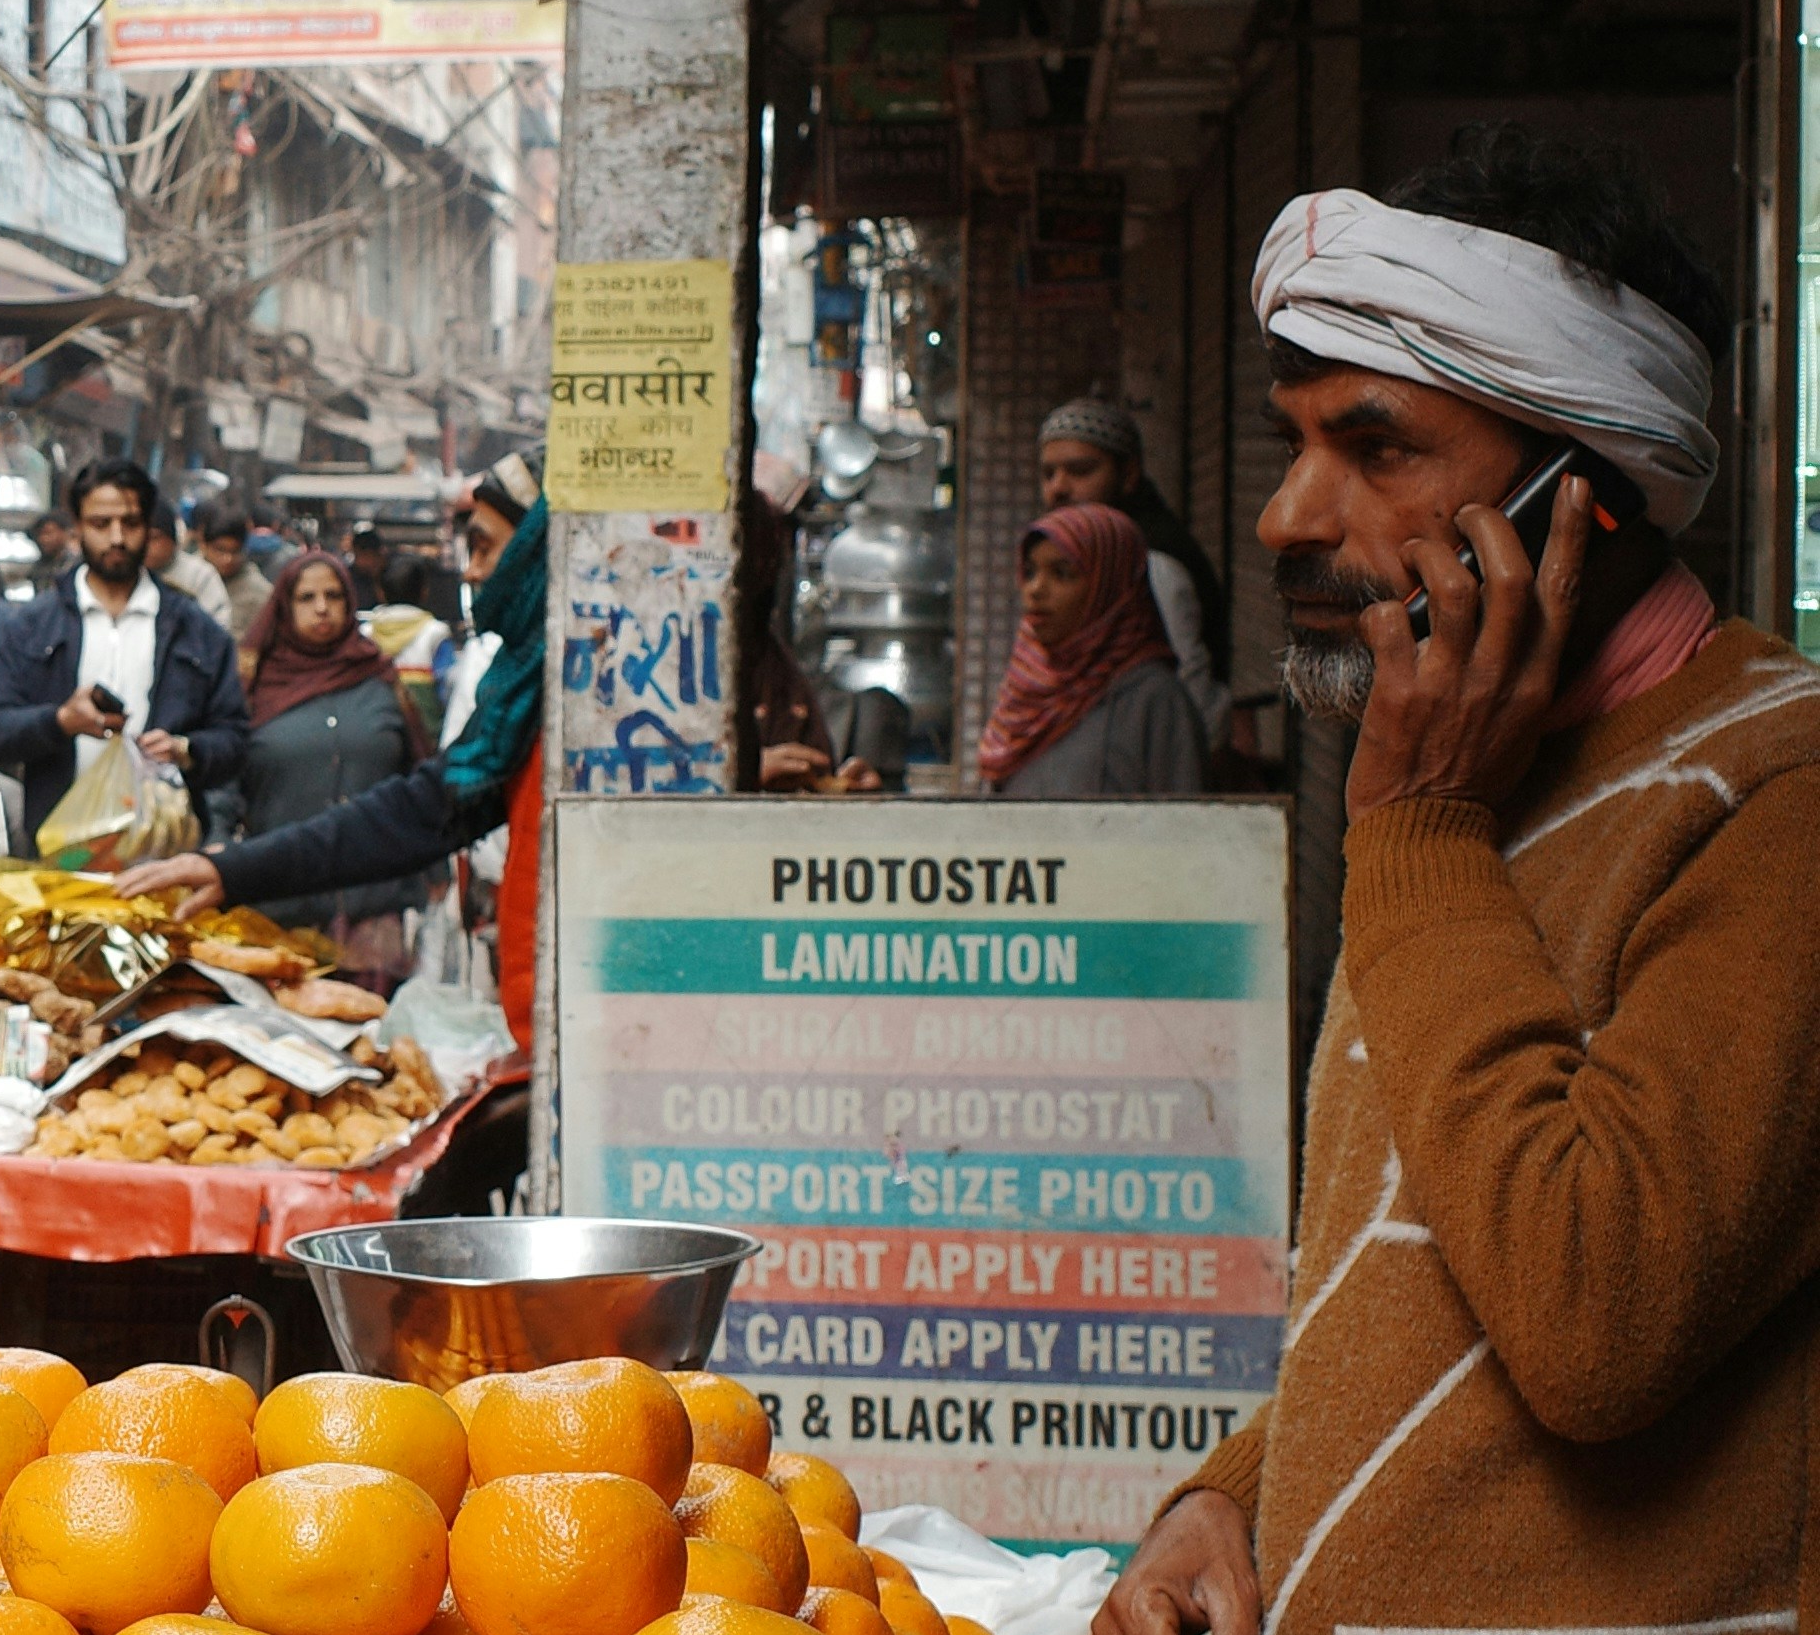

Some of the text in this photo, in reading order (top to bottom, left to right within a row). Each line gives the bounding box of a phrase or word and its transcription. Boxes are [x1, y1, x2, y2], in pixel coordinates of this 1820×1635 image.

[772, 856, 1066, 906] PHOTOSTAT
[760, 933, 1078, 985] LAMINATION
[716, 1009, 1126, 1064] SPIRAL BINDING
[662, 1085, 1181, 1143] COLOUR PHOTOSTAT
[631, 1160, 1216, 1222] PASSPORT SIZE PHOTO
[904, 1243, 1059, 1296] APPLY
[1082, 1245, 1218, 1299] HERE
[745, 1313, 885, 1367] CARD
[900, 1318, 1061, 1372] APPLY
[1077, 1322, 1215, 1377] HERE
[802, 1394, 831, 1439] &
[851, 1395, 993, 1445] BLACK
[1012, 1399, 1238, 1452] PRINTOUT
